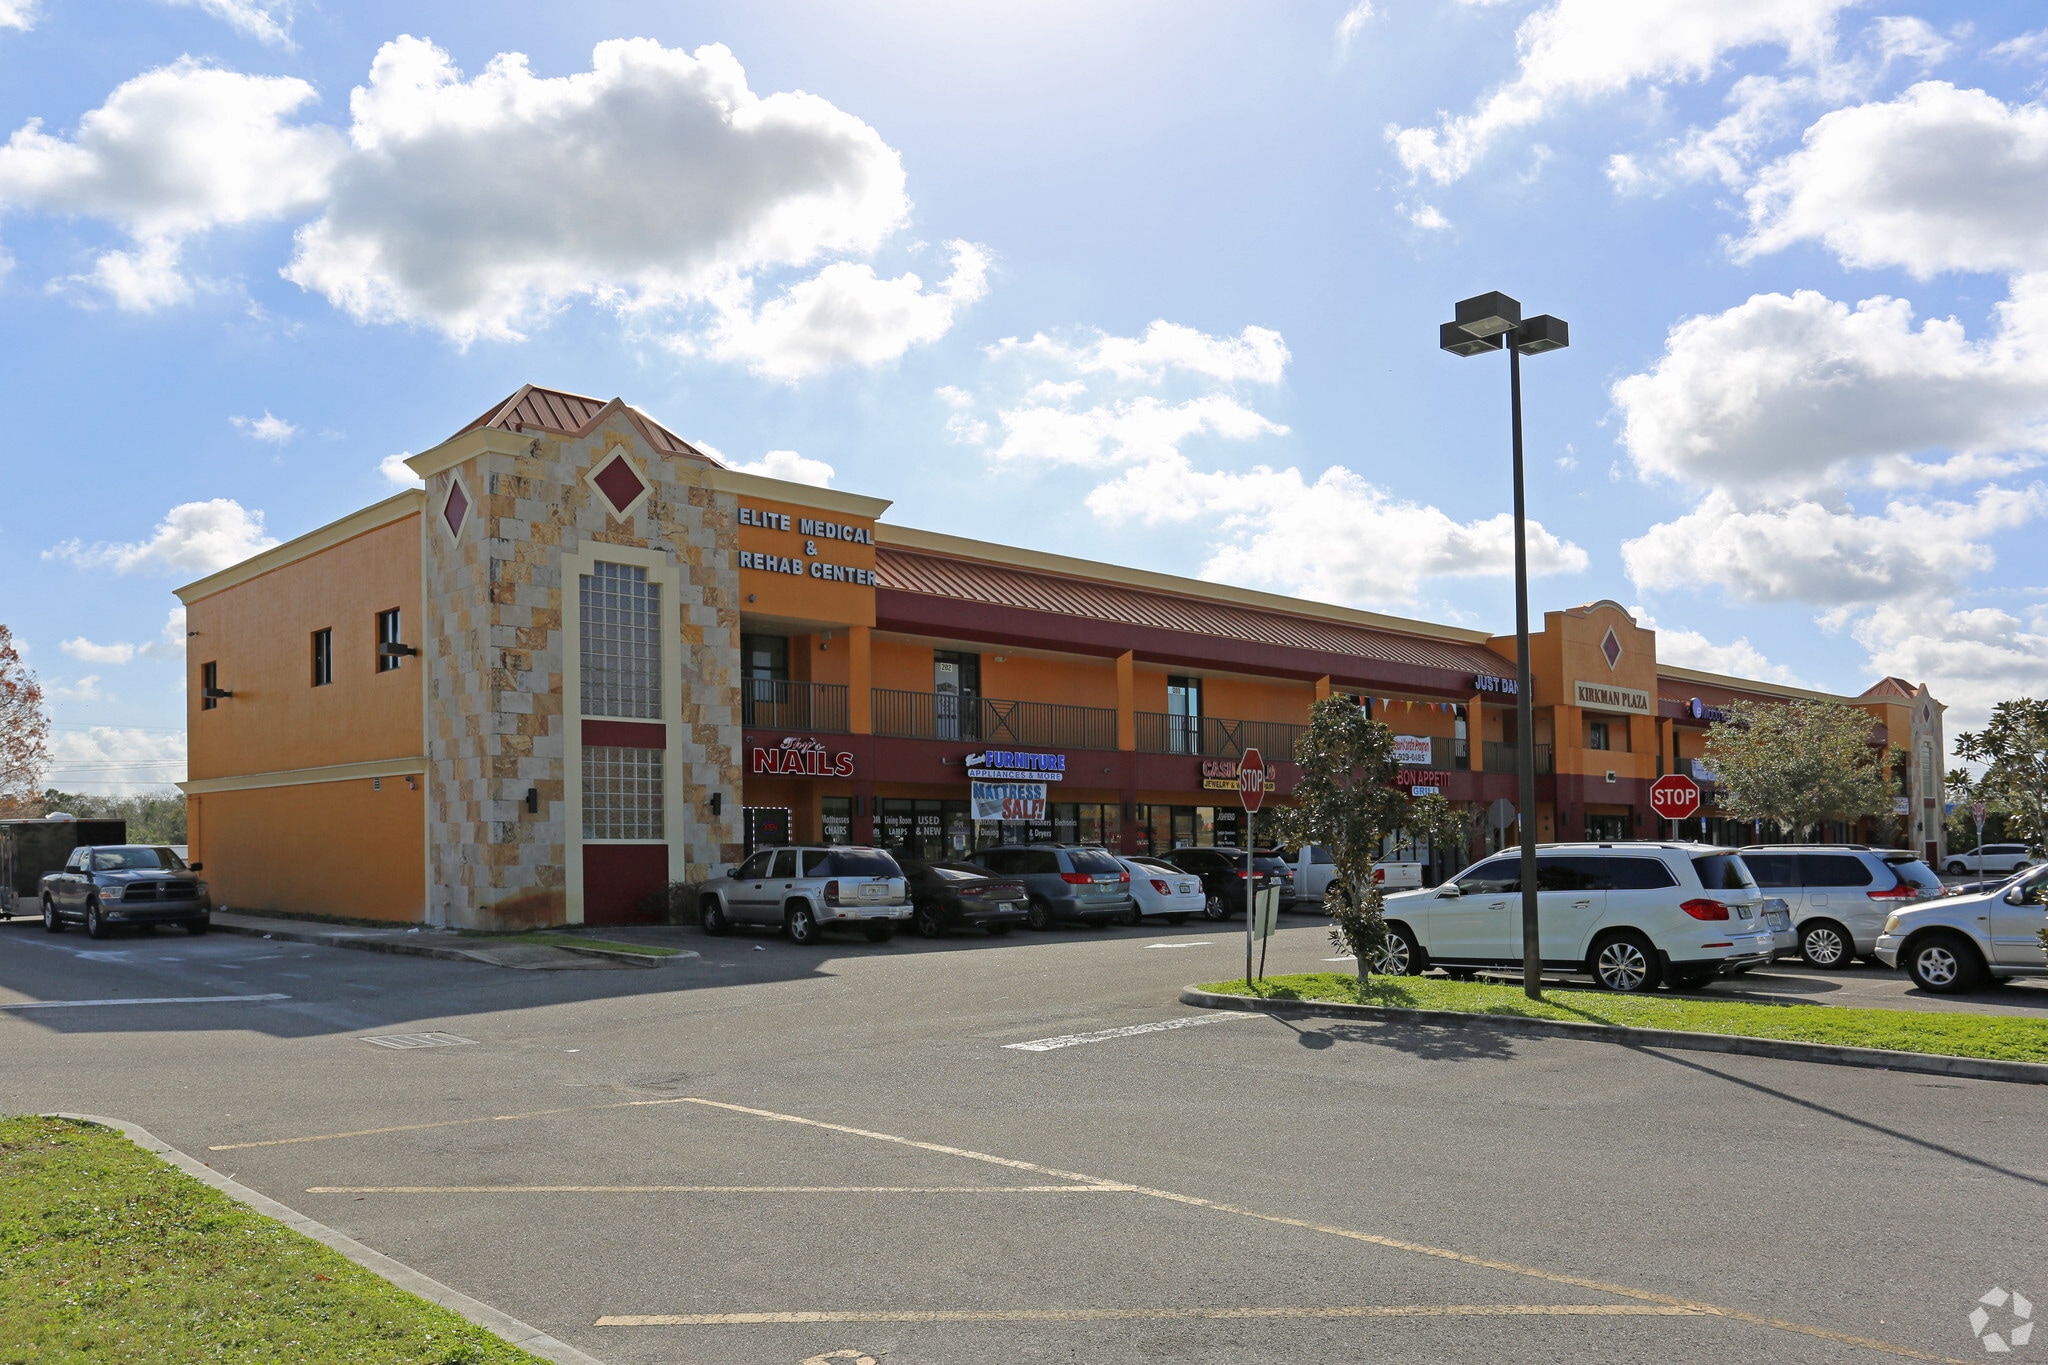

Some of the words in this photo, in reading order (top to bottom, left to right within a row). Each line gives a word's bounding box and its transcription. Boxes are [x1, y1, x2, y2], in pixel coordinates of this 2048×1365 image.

[739, 507, 791, 532] ELITE
[799, 518, 875, 545] MEDICAL
[804, 540, 818, 556] &
[739, 551, 804, 575] REHAB
[810, 562, 877, 586] CENTER
[941, 664, 952, 672] 202
[1475, 674, 1500, 692] JUST
[1578, 686, 1620, 706] KIRKMAN
[1622, 692, 1648, 710] PLAZA
[753, 747, 854, 777] NAILS
[985, 750, 1066, 771] FURNITURE
[1203, 760, 1236, 778] CASH
[969, 769, 1026, 779] APPLIANCES
[1037, 772, 1061, 780] MORE
[1241, 768, 1263, 792] STOP
[1397, 770, 1416, 786] BON
[1418, 771, 1451, 787] APPETIT
[973, 783, 1042, 801] MATTRESS
[1204, 780, 1229, 788] JEWELRY
[1413, 787, 1437, 795] GRILL
[1654, 788, 1697, 805] STOP
[1002, 798, 1044, 819] SALE!
[917, 815, 940, 825] USED
[824, 825, 847, 835] CHAIRS
[888, 827, 908, 836] LAMPS
[924, 827, 941, 836] NEW
[1035, 828, 1052, 839] Dryers
